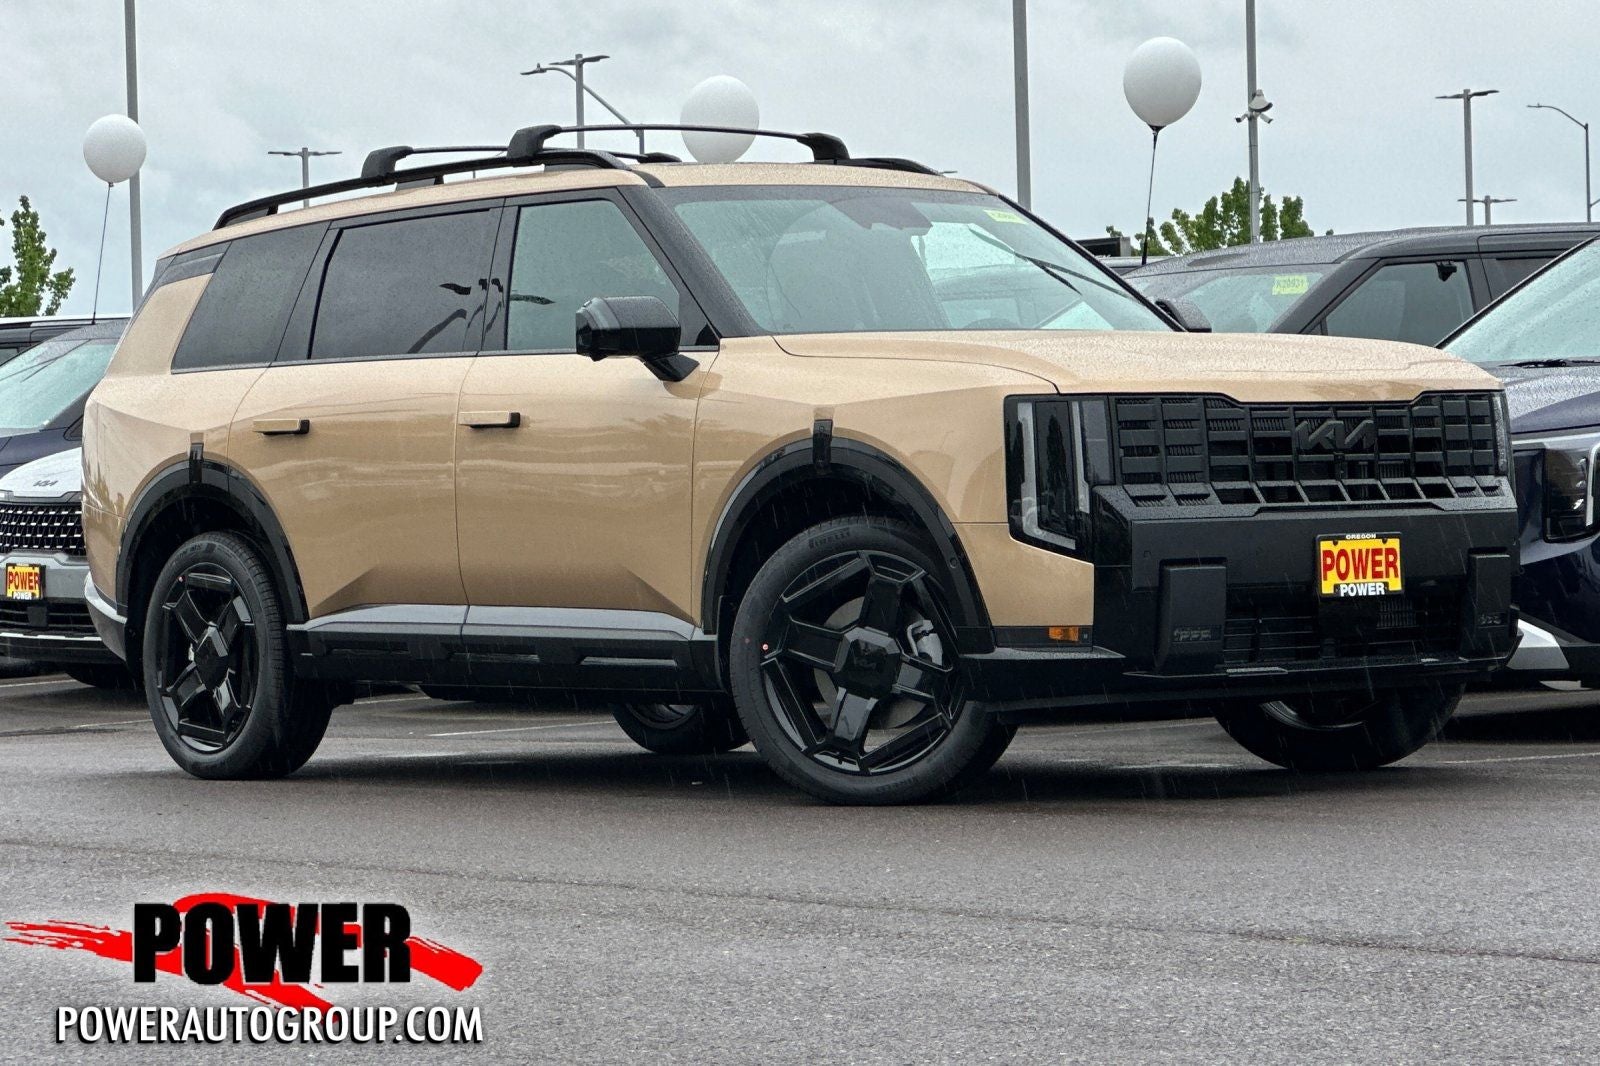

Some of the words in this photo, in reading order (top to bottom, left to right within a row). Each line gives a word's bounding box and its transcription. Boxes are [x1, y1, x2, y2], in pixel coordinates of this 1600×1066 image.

[1322, 547, 1399, 581] POWER
[8, 571, 40, 590] POWER
[1340, 582, 1385, 597] POWER
